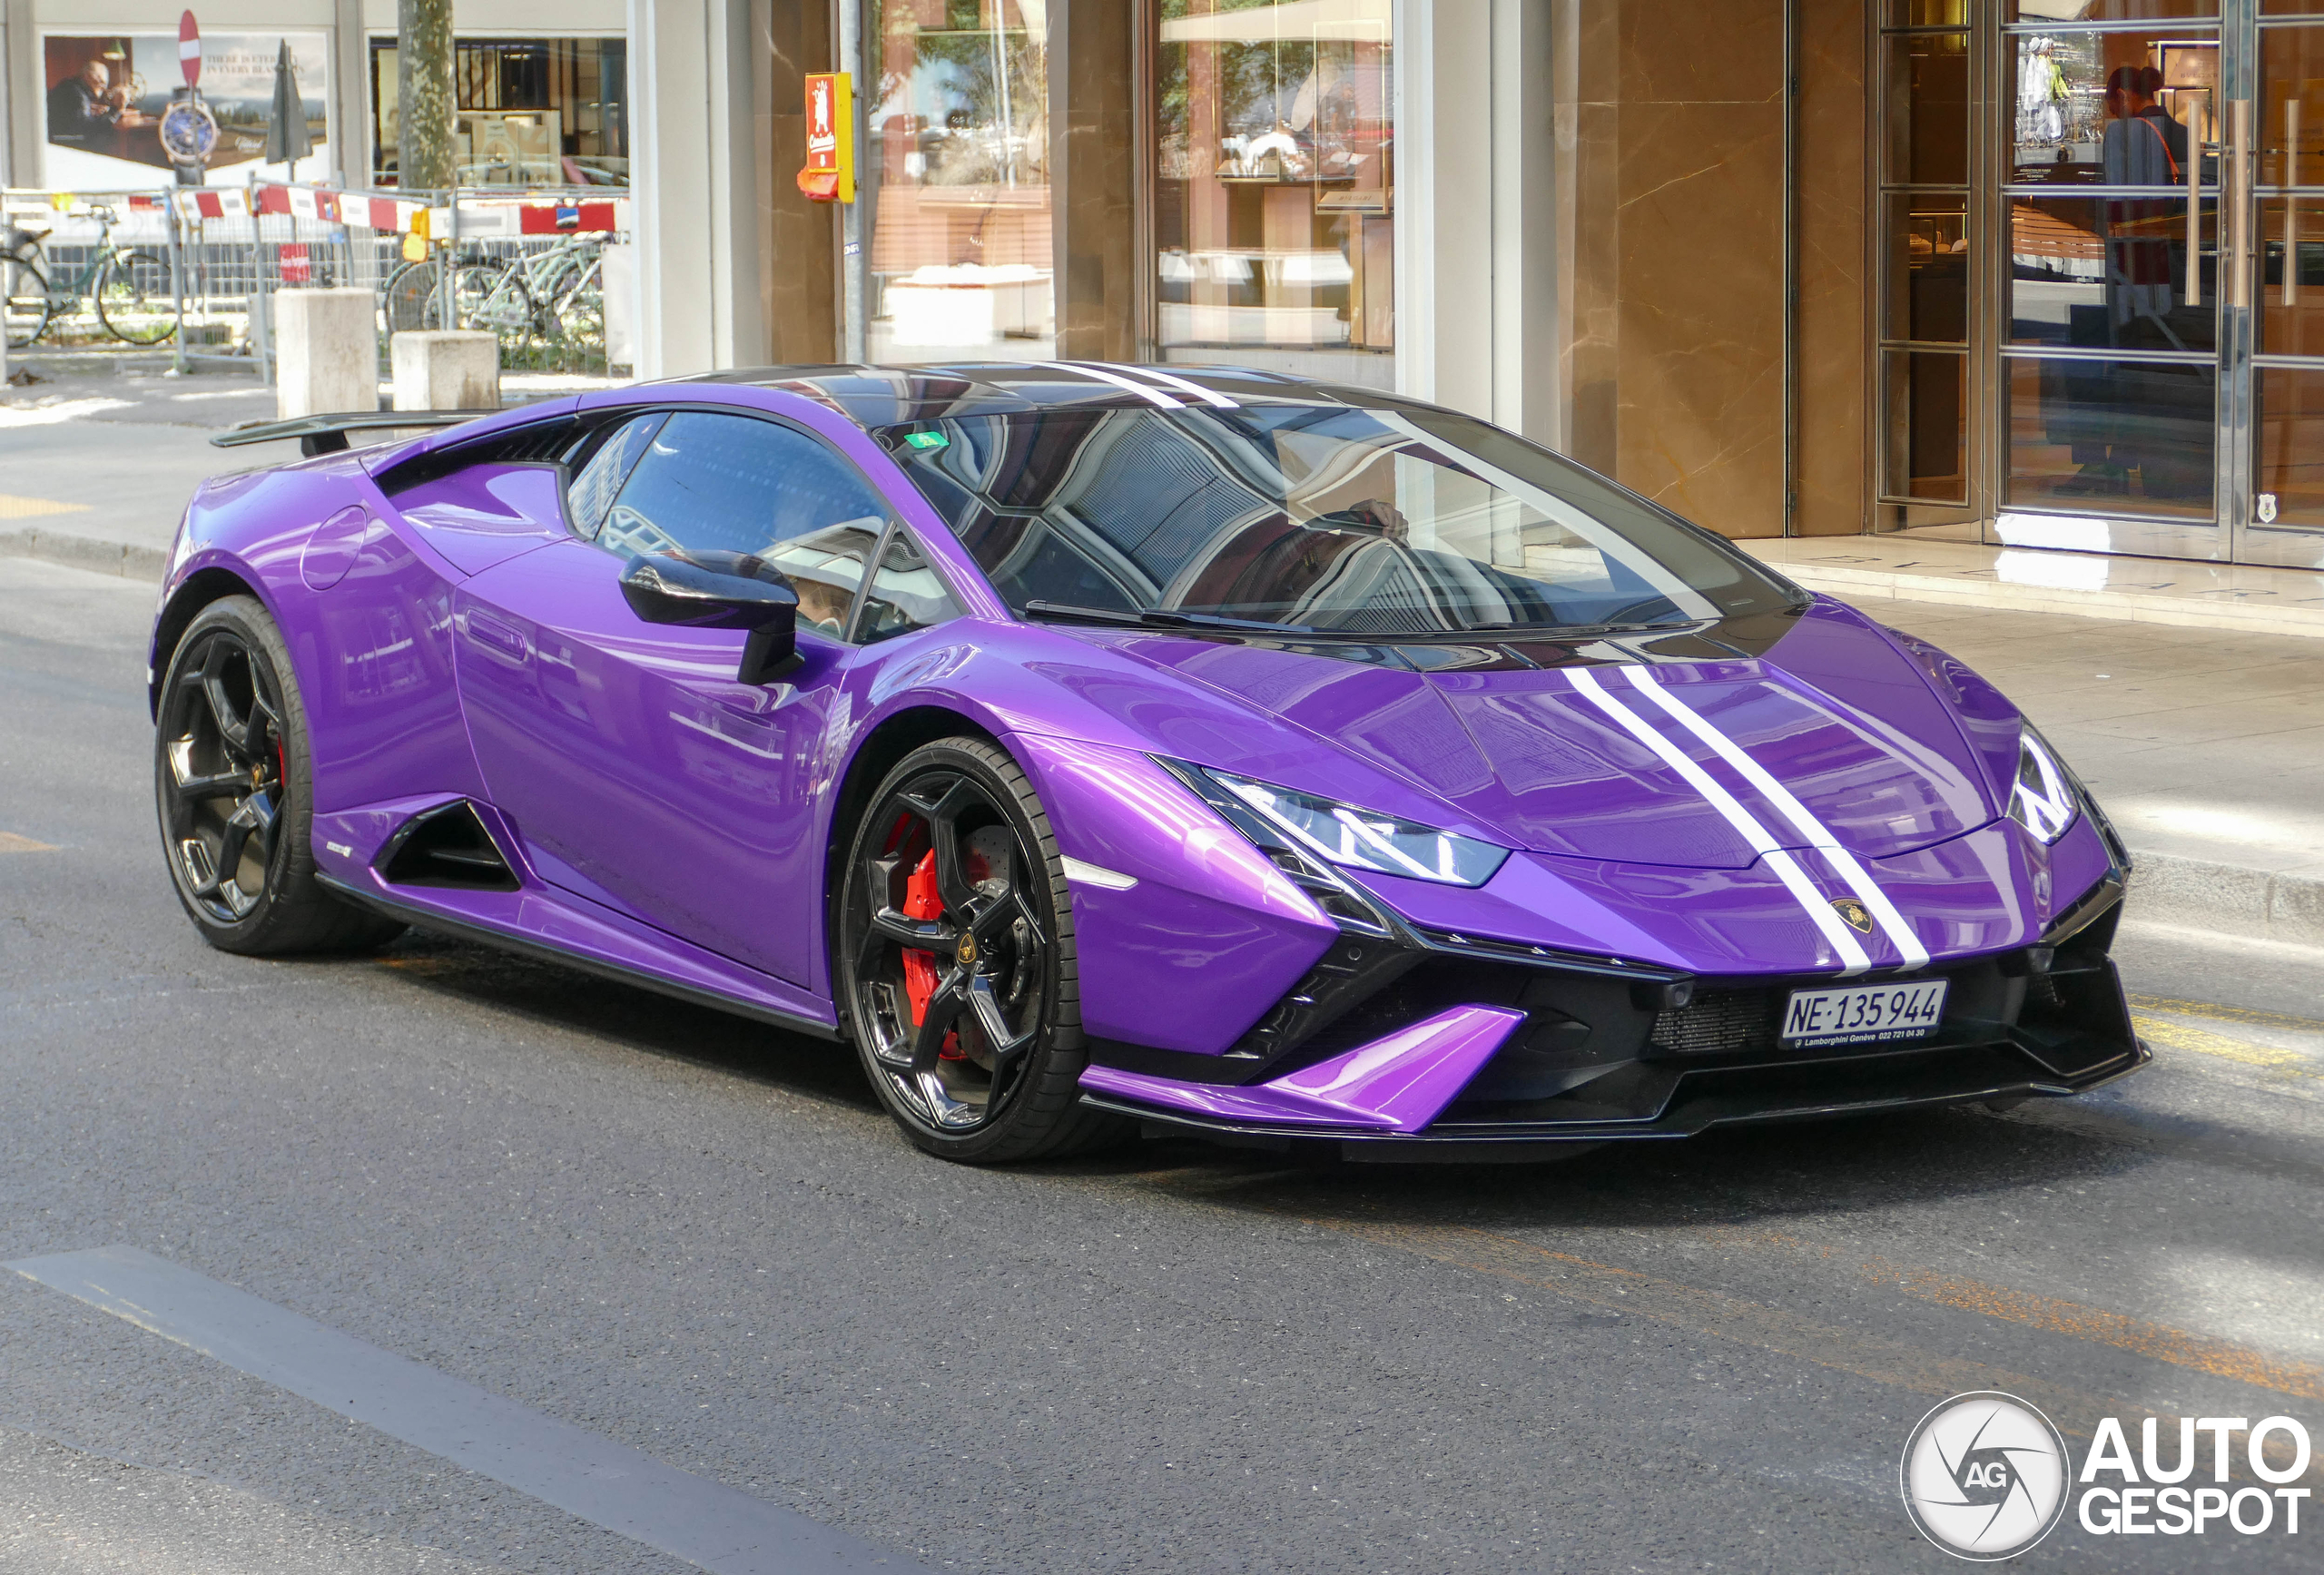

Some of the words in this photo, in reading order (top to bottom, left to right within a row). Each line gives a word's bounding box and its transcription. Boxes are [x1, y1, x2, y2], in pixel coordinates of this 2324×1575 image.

[1805, 1036, 1849, 1047] Lamborghini
[1849, 1033, 1876, 1043] Genève
[1878, 1031, 1892, 1040] 022
[1893, 1030, 1905, 1039] 721
[1905, 1029, 1915, 1038] 04
[1915, 1029, 1925, 1037] 30
